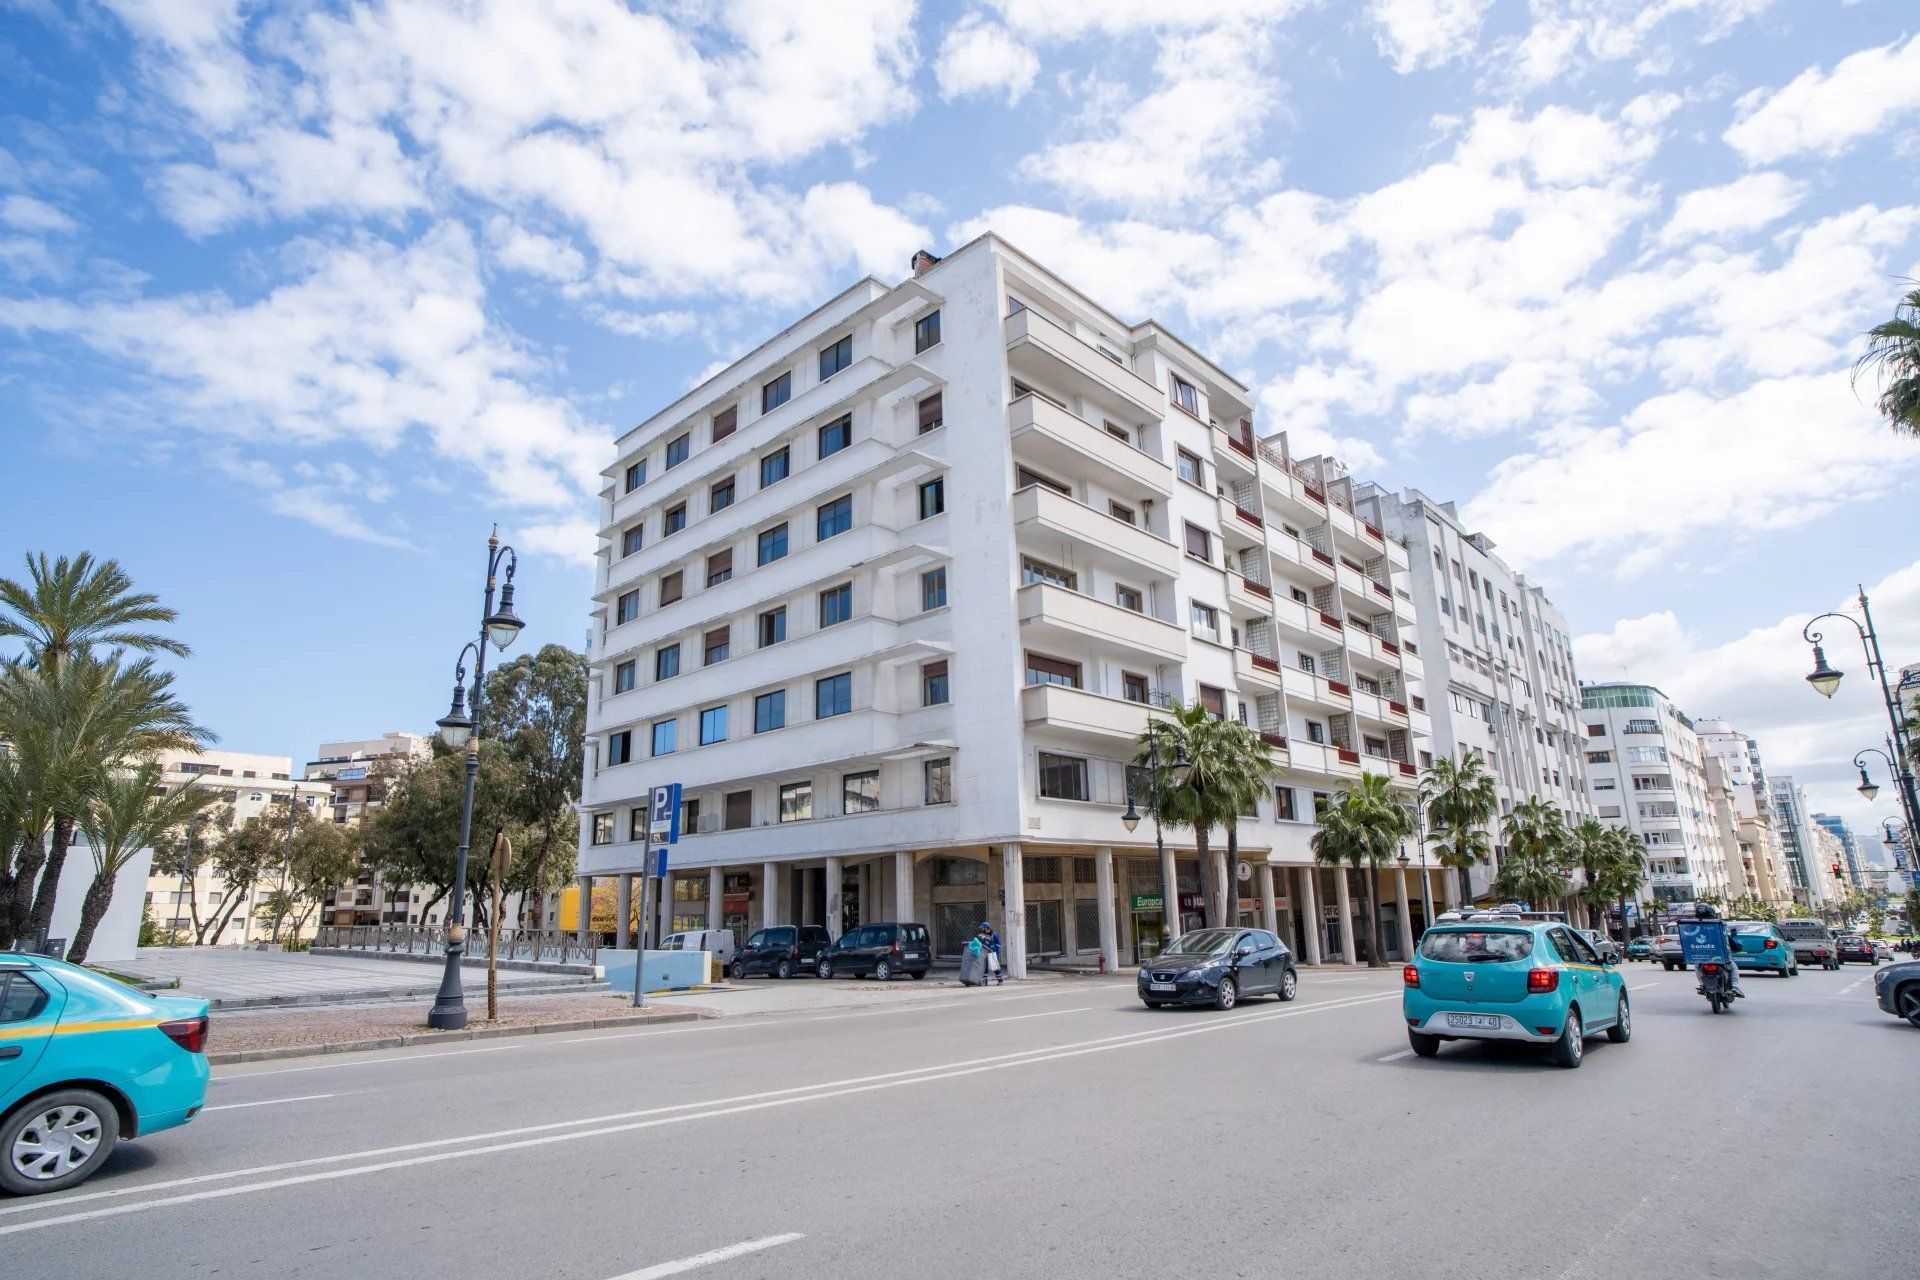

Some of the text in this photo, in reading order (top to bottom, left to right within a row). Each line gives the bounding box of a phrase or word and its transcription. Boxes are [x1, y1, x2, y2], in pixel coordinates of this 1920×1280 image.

[654, 788, 668, 821] P
[1136, 896, 1163, 907] Europca
[1450, 1015, 1473, 1025] 25023
[1489, 1017, 1497, 1026] 40
